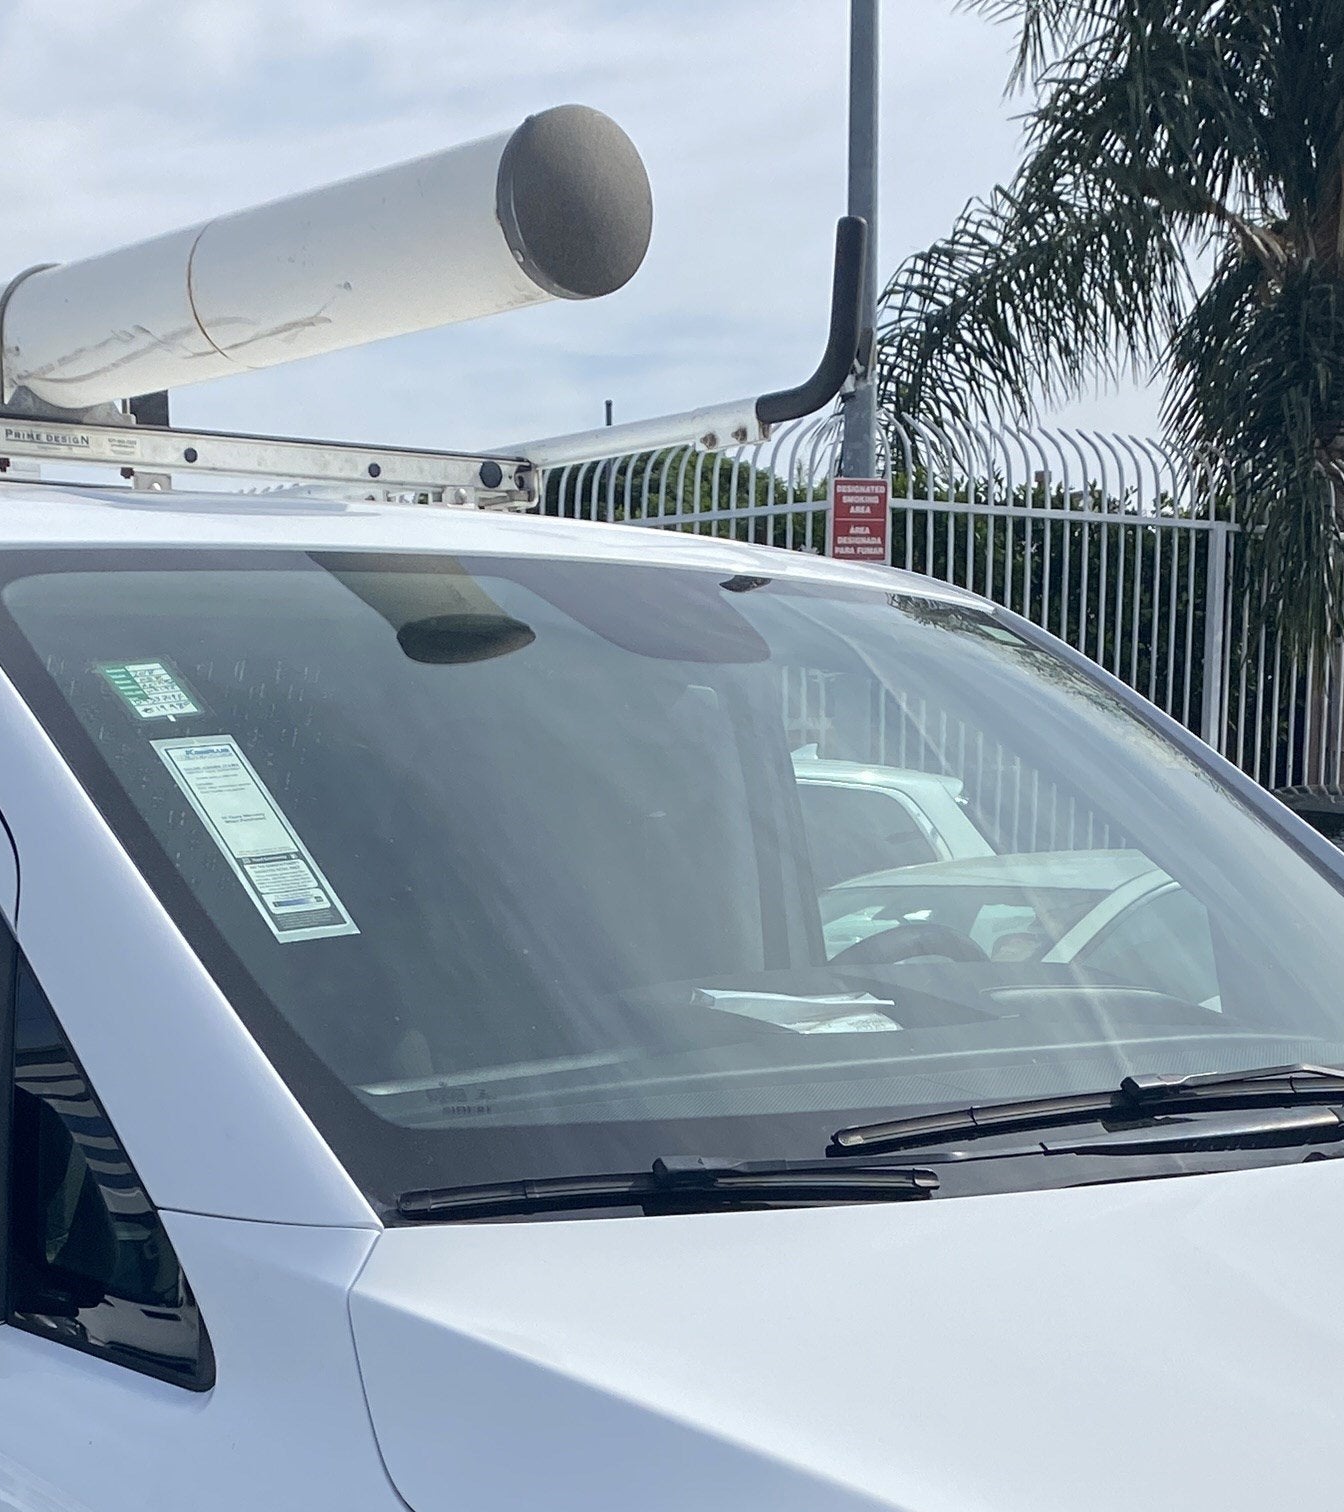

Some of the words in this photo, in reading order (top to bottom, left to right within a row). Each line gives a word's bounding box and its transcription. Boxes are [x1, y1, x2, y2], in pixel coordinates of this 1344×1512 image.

[836, 484, 886, 494] DESIGNATED
[842, 495, 880, 504] SMOKING
[849, 505, 871, 514] AREA
[837, 536, 882, 545] DESIGNADA
[834, 546, 855, 554] PARA
[857, 546, 884, 555] FUMAR
